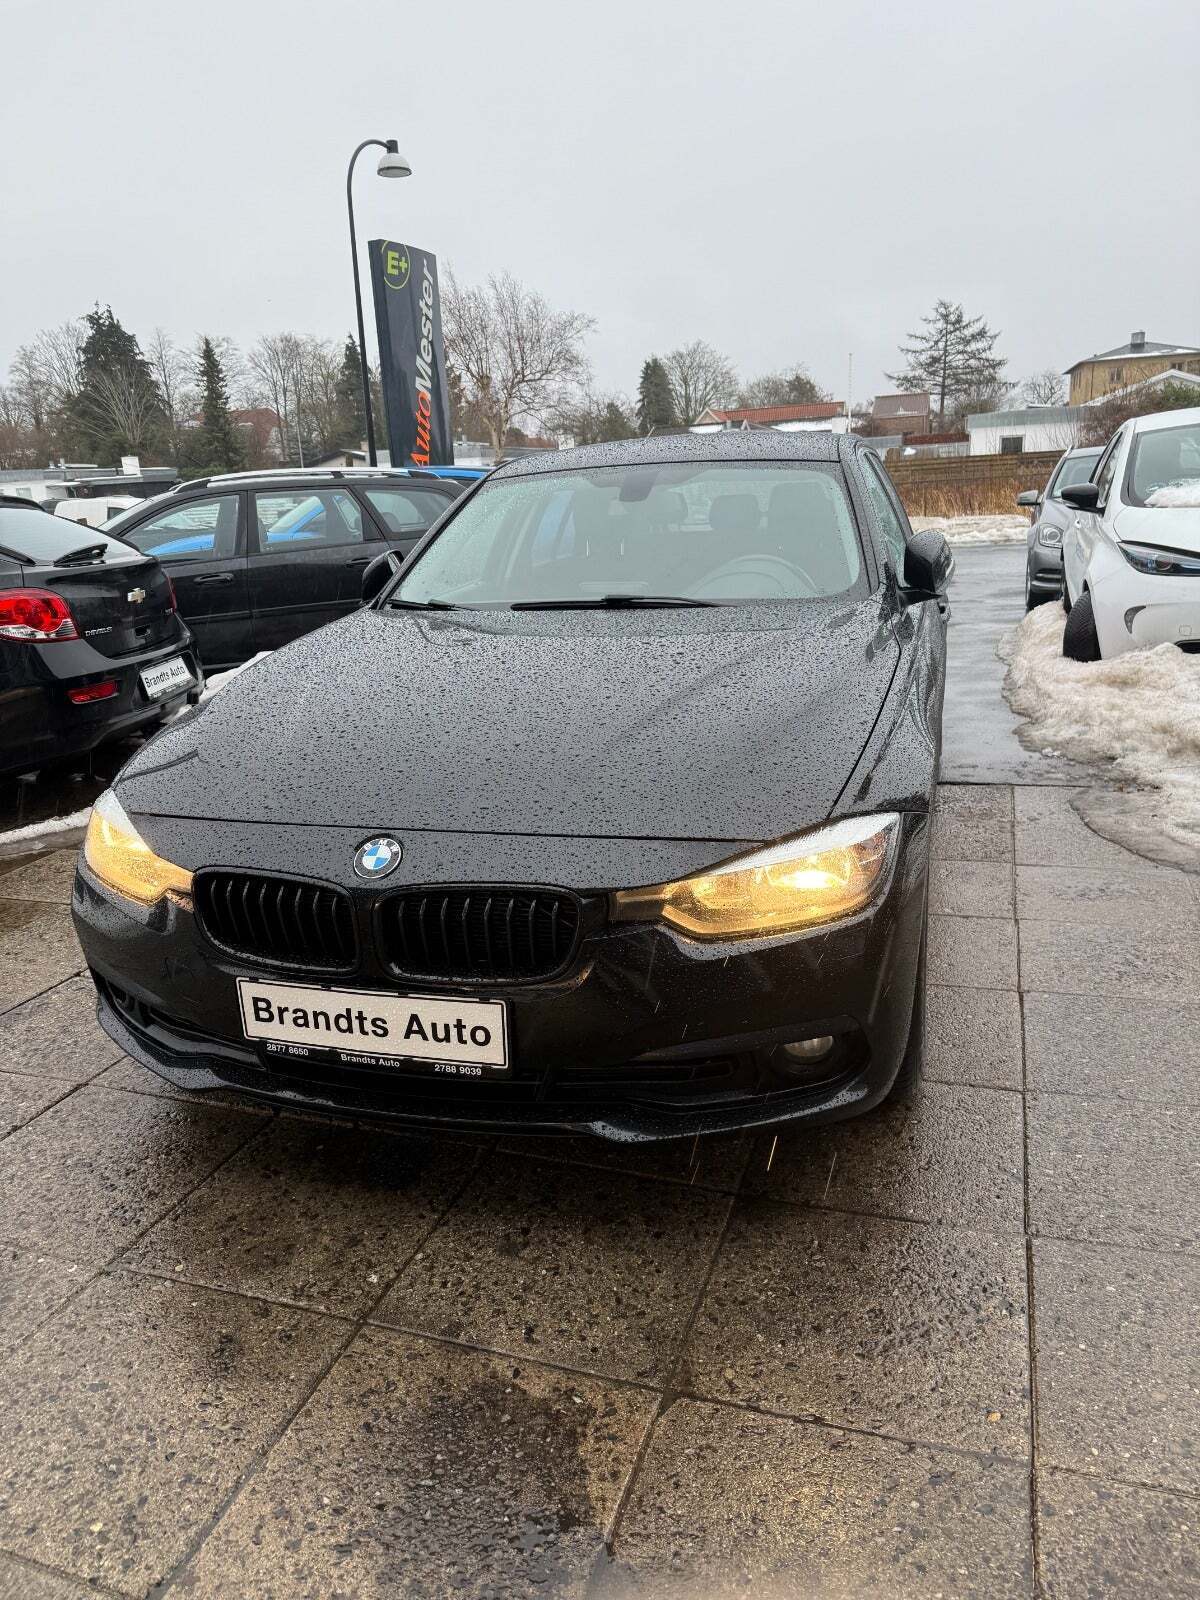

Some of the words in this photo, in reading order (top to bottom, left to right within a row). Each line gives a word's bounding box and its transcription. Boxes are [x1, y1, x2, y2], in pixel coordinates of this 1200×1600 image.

[386, 251, 408, 276] E+
[410, 258, 435, 468] AutoMester
[144, 671, 170, 688] Brandts
[170, 665, 186, 678] Auto
[251, 996, 389, 1038] Brandts
[403, 1013, 491, 1047] Auto
[266, 1043, 286, 1053] 2877
[340, 1053, 376, 1065] Brandts
[378, 1058, 400, 1068] Auto
[434, 1064, 457, 1074] 2788
[459, 1066, 482, 1076] 9039
